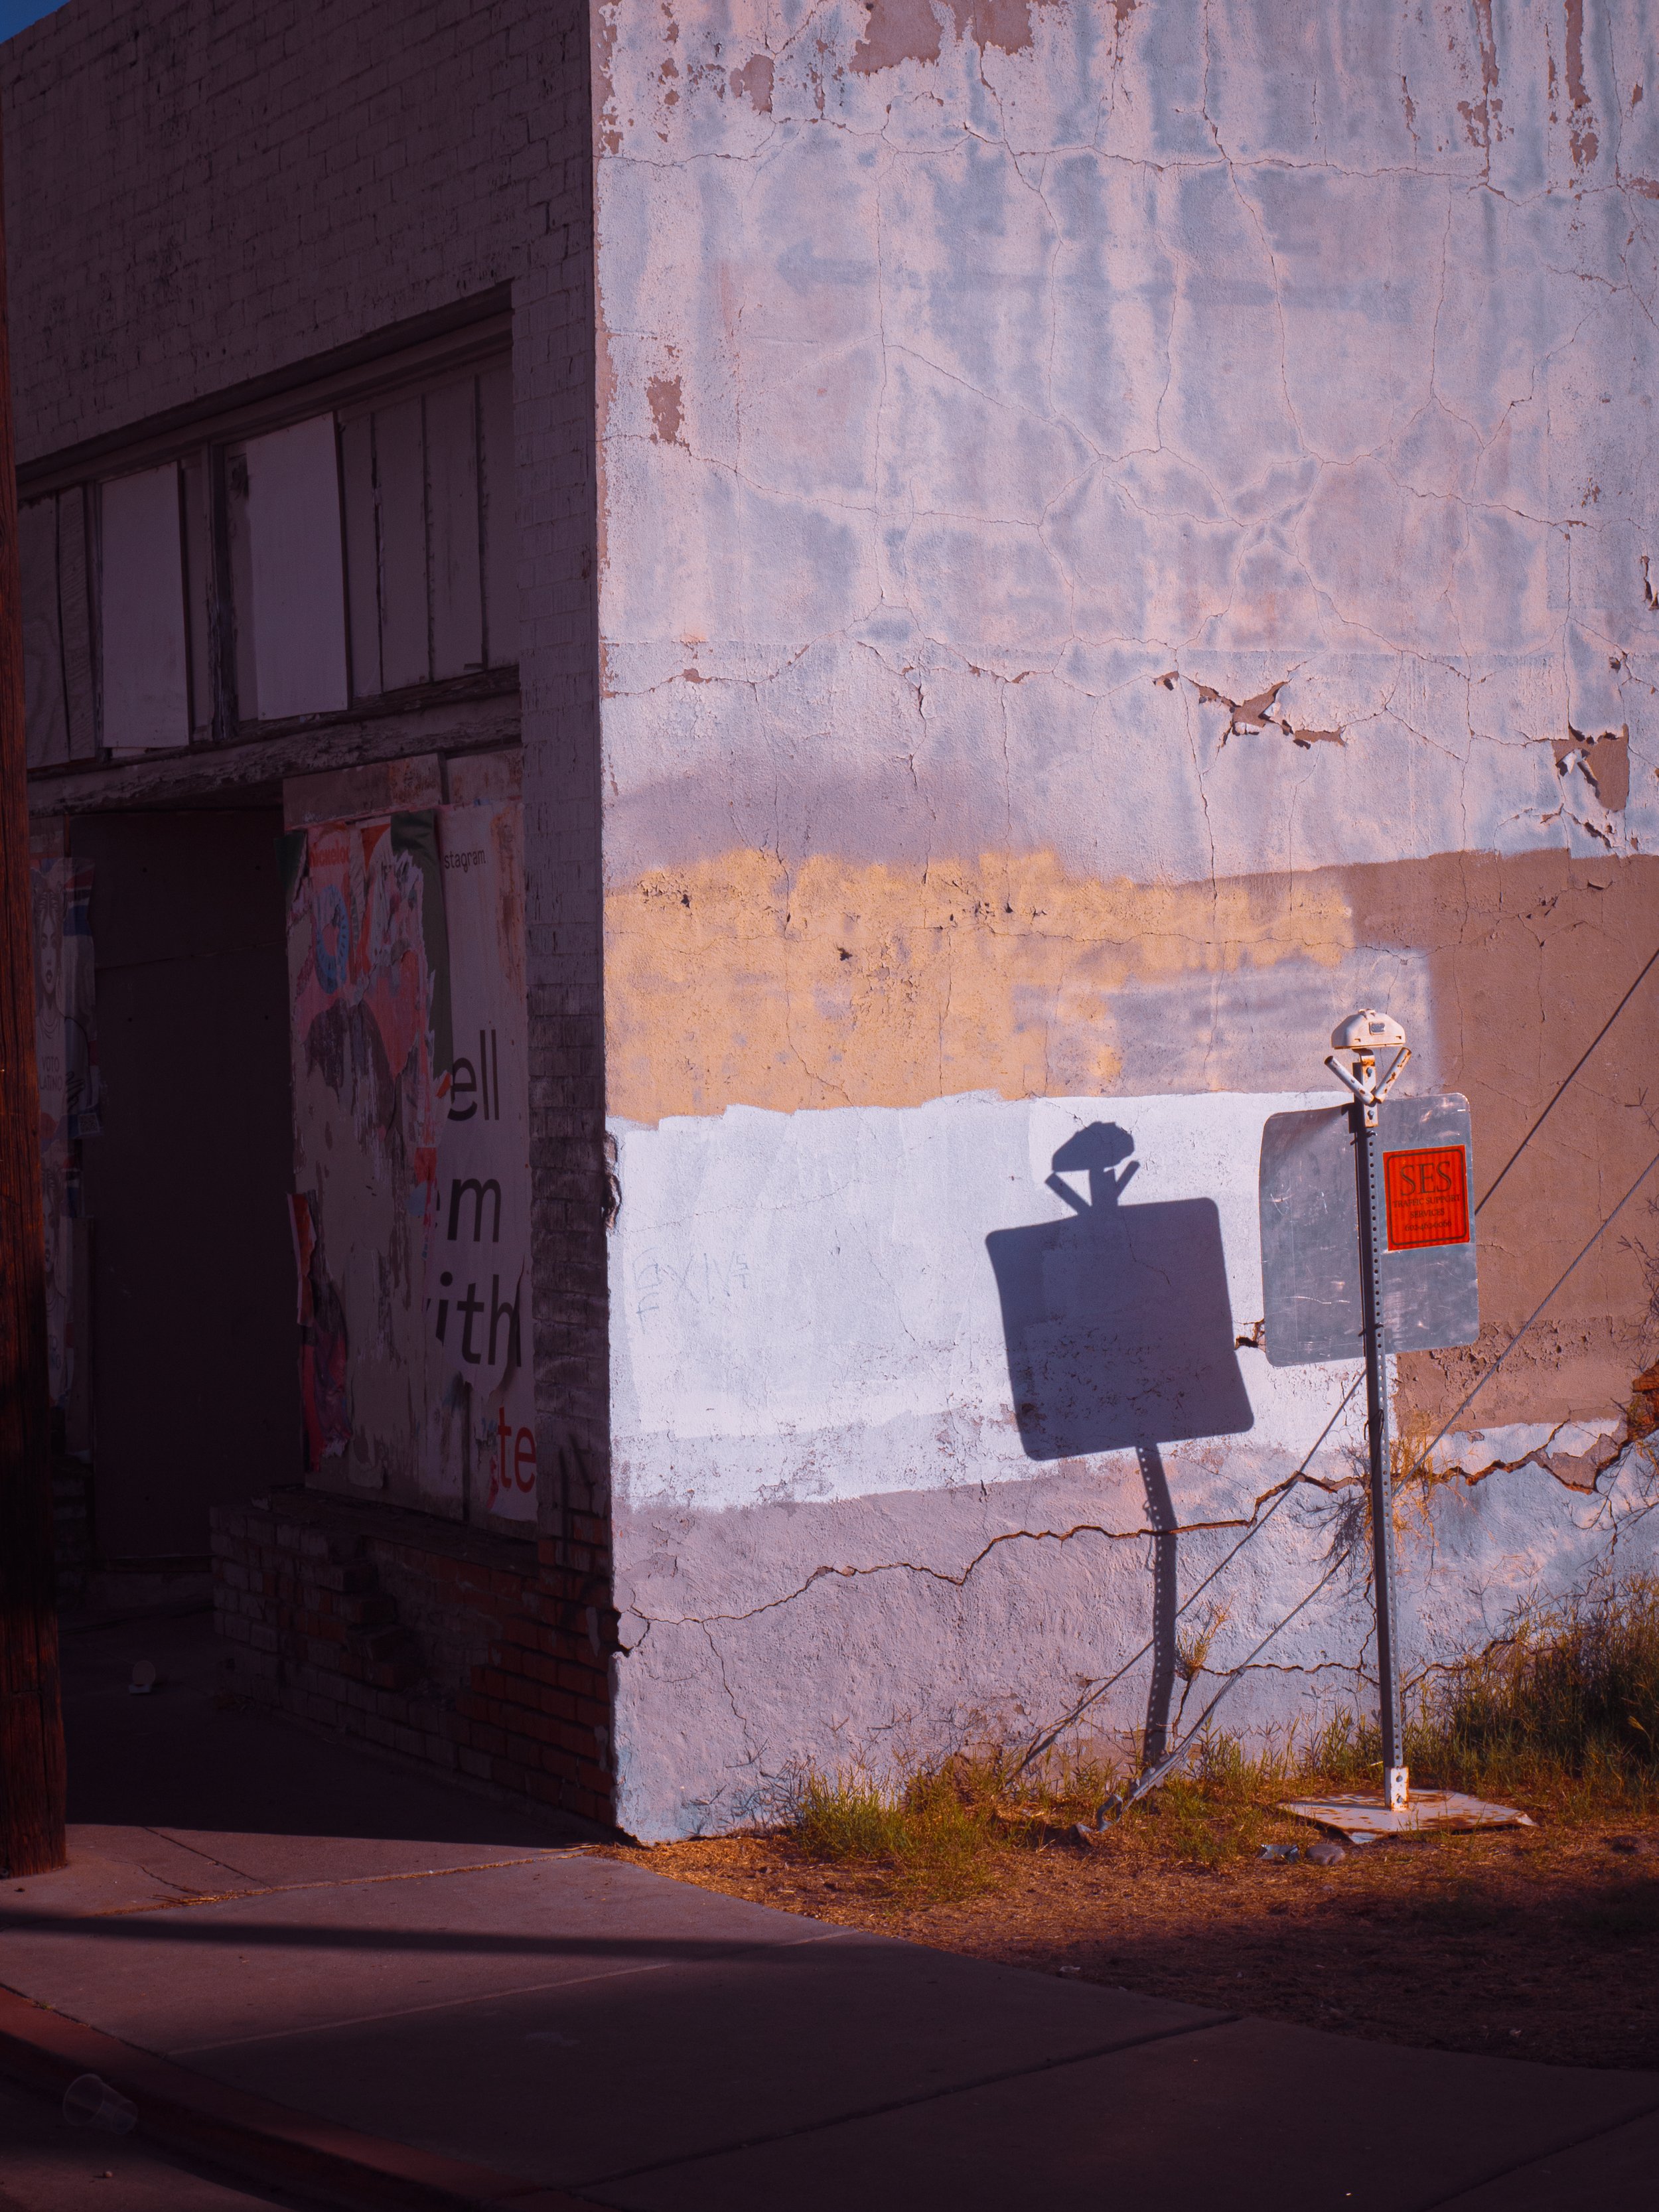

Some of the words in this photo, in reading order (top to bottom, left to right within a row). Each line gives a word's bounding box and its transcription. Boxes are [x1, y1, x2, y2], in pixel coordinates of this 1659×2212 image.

[444, 849, 486, 873] stagram
[41, 1055, 60, 1072] VOTO
[40, 1074, 63, 1092] LATINO
[1400, 1161, 1452, 1197] SES
[435, 1178, 502, 1243] m
[1393, 1197, 1424, 1208] TRAFFIC
[1426, 1194, 1461, 1205] SUPPORT
[1409, 1208, 1445, 1218] SERVICES
[425, 1270, 522, 1366] ith
[497, 1405, 538, 1494] te
